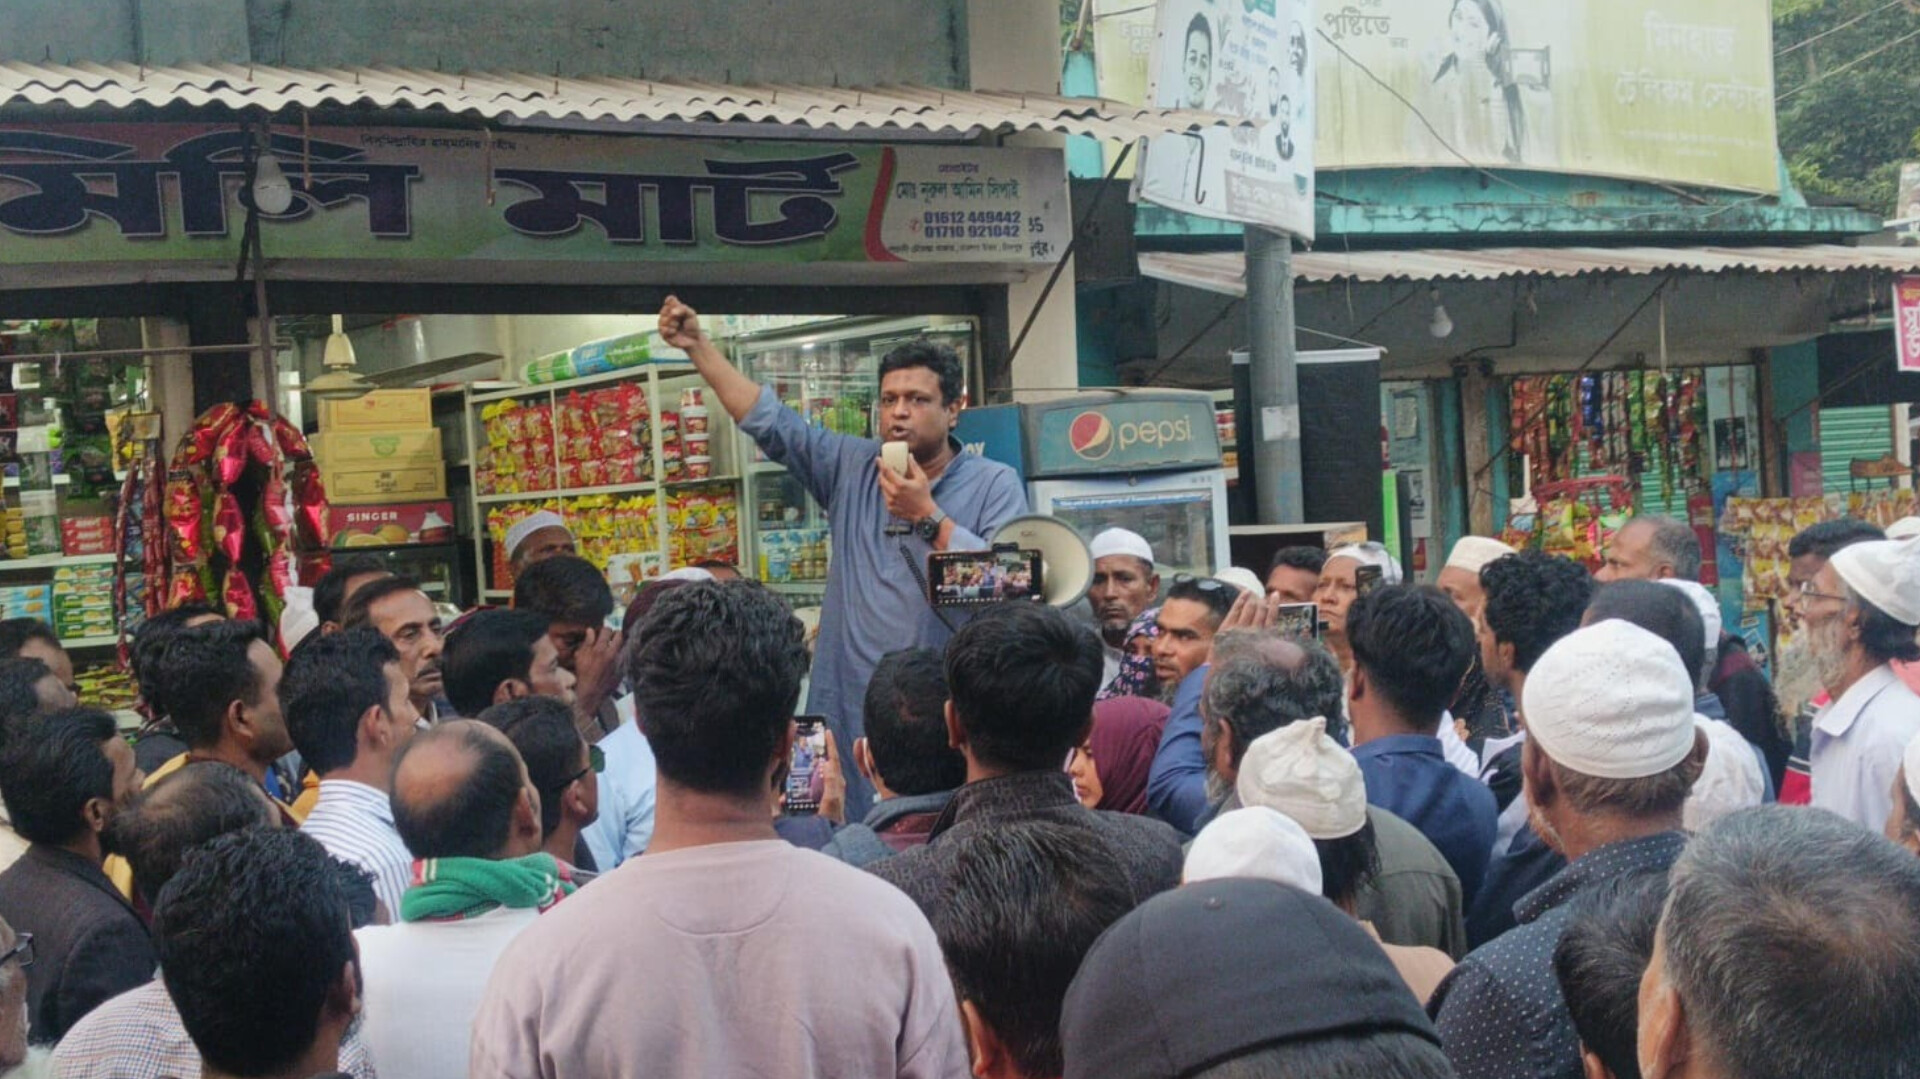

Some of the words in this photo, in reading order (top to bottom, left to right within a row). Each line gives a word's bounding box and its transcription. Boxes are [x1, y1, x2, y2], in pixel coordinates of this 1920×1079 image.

[1324, 6, 1391, 40] পুষ্টিতে
[494, 151, 861, 245] মার্ট
[925, 225, 965, 238] 01710
[1118, 414, 1193, 450] pepsi
[346, 512, 398, 522] SINGER
